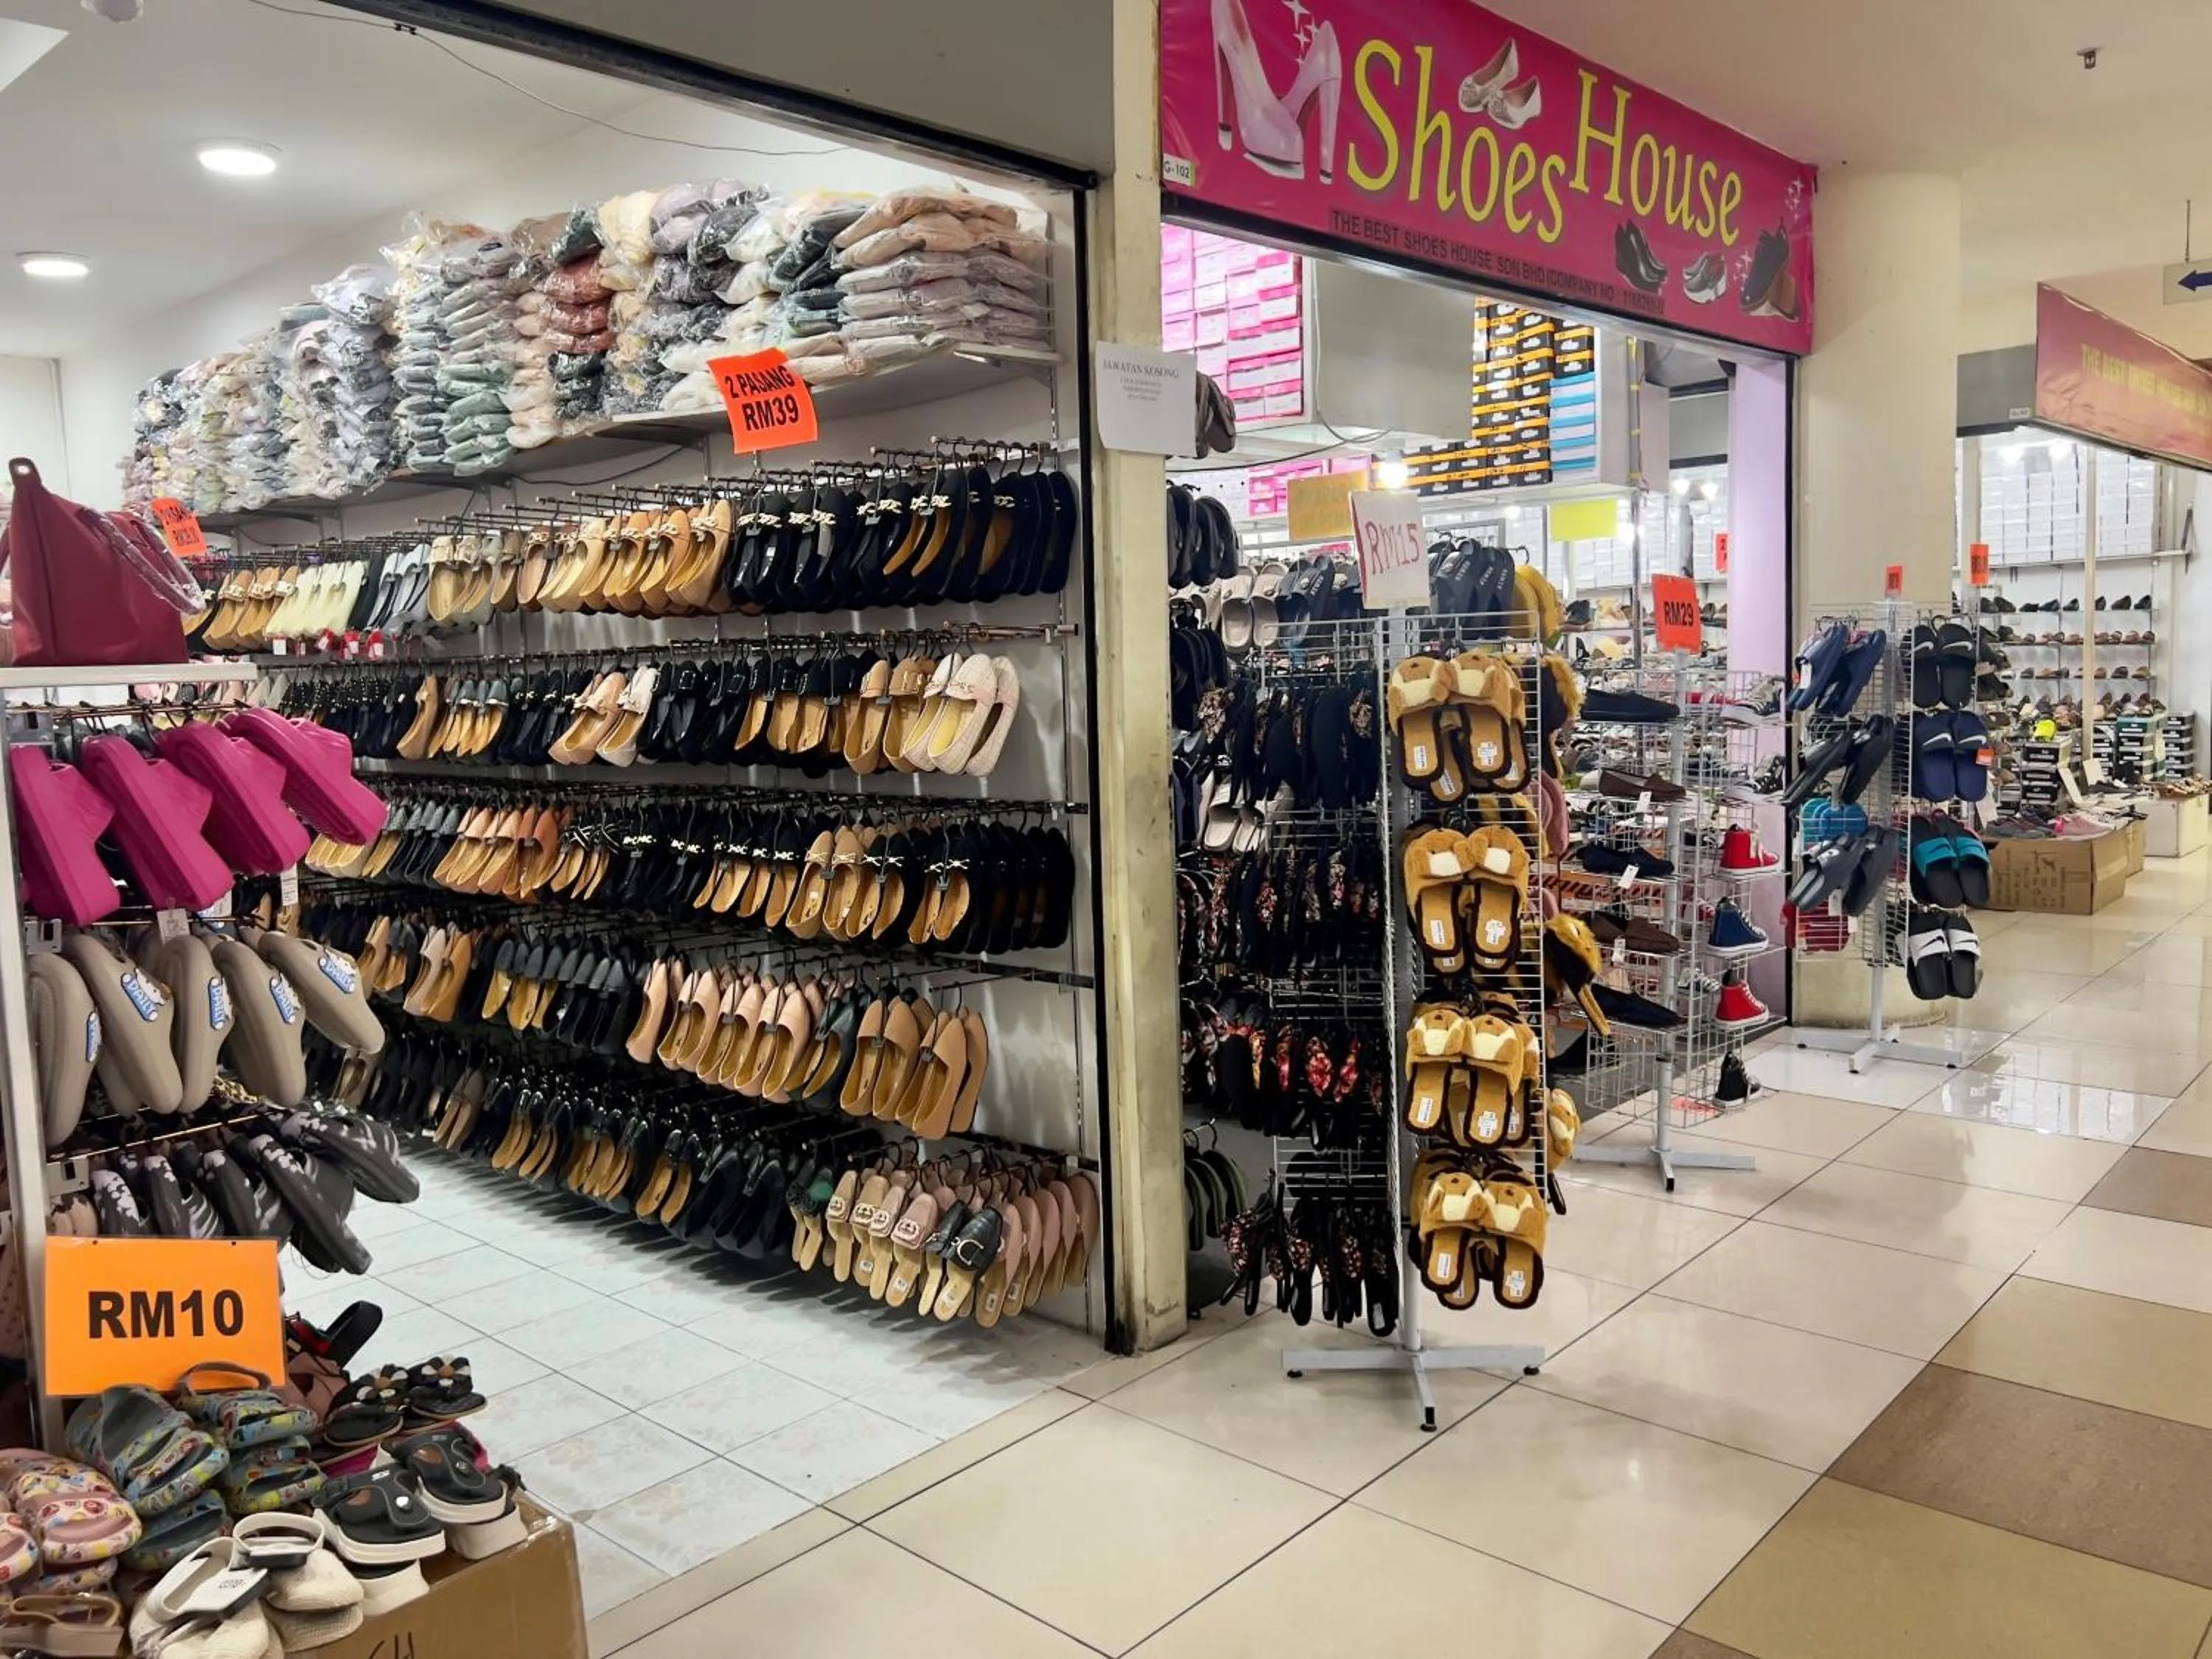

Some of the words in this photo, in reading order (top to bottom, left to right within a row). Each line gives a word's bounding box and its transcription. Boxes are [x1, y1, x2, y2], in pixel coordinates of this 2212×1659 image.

[1347, 38, 1565, 243] Shoes
[1568, 69, 1742, 246] House
[1332, 209, 1361, 236] THE
[1363, 218, 1400, 246] BEST
[1404, 230, 1448, 259] SHOES
[1450, 242, 1492, 270] HOUSE
[1498, 256, 1520, 277] SDN
[1523, 262, 1545, 284] BHD
[725, 375, 740, 399] 2
[740, 365, 796, 397] PASANG
[742, 394, 799, 431] RM39
[1365, 521, 1420, 575] RM15
[1663, 601, 1694, 627] RM29
[88, 1289, 244, 1339] RM10
